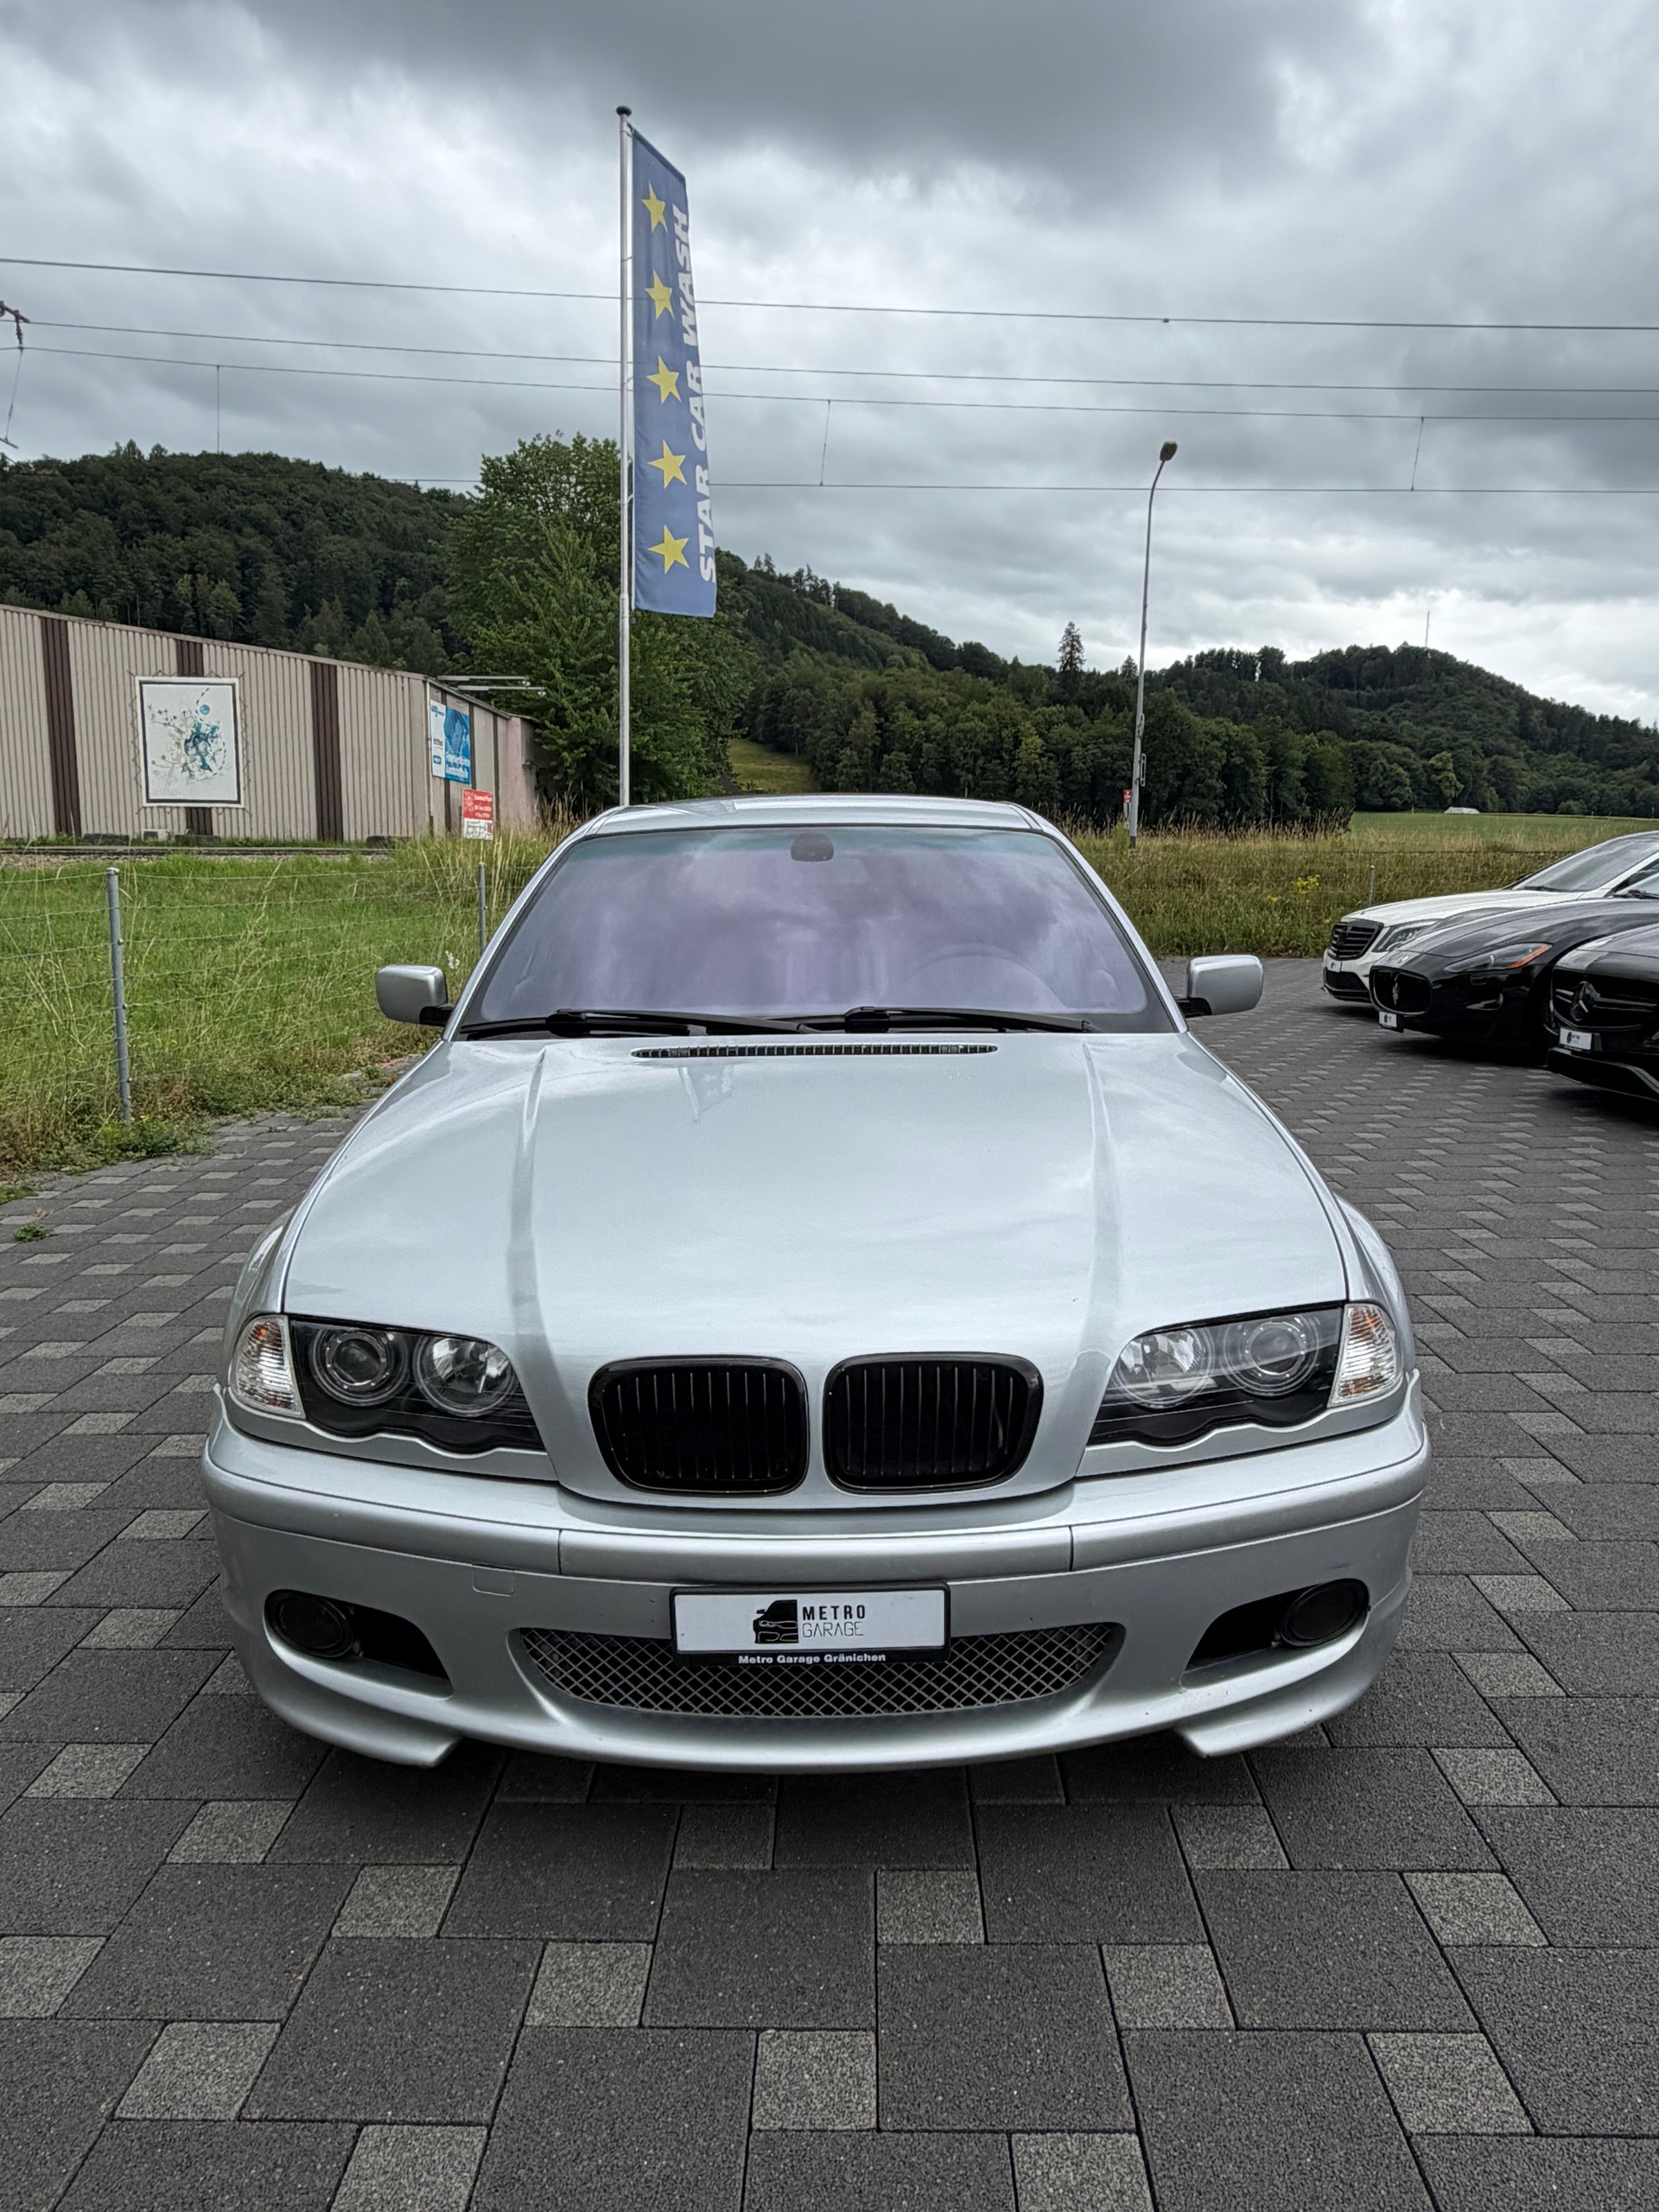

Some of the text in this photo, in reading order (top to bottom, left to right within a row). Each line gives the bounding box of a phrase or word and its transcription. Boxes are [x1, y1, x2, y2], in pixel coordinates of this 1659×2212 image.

[672, 203, 716, 583] STAR CAR WASH
[802, 1605, 866, 1621] METRO
[802, 1621, 864, 1638] GARAGE
[738, 1653, 887, 1665] Metro Garage Gränichen
